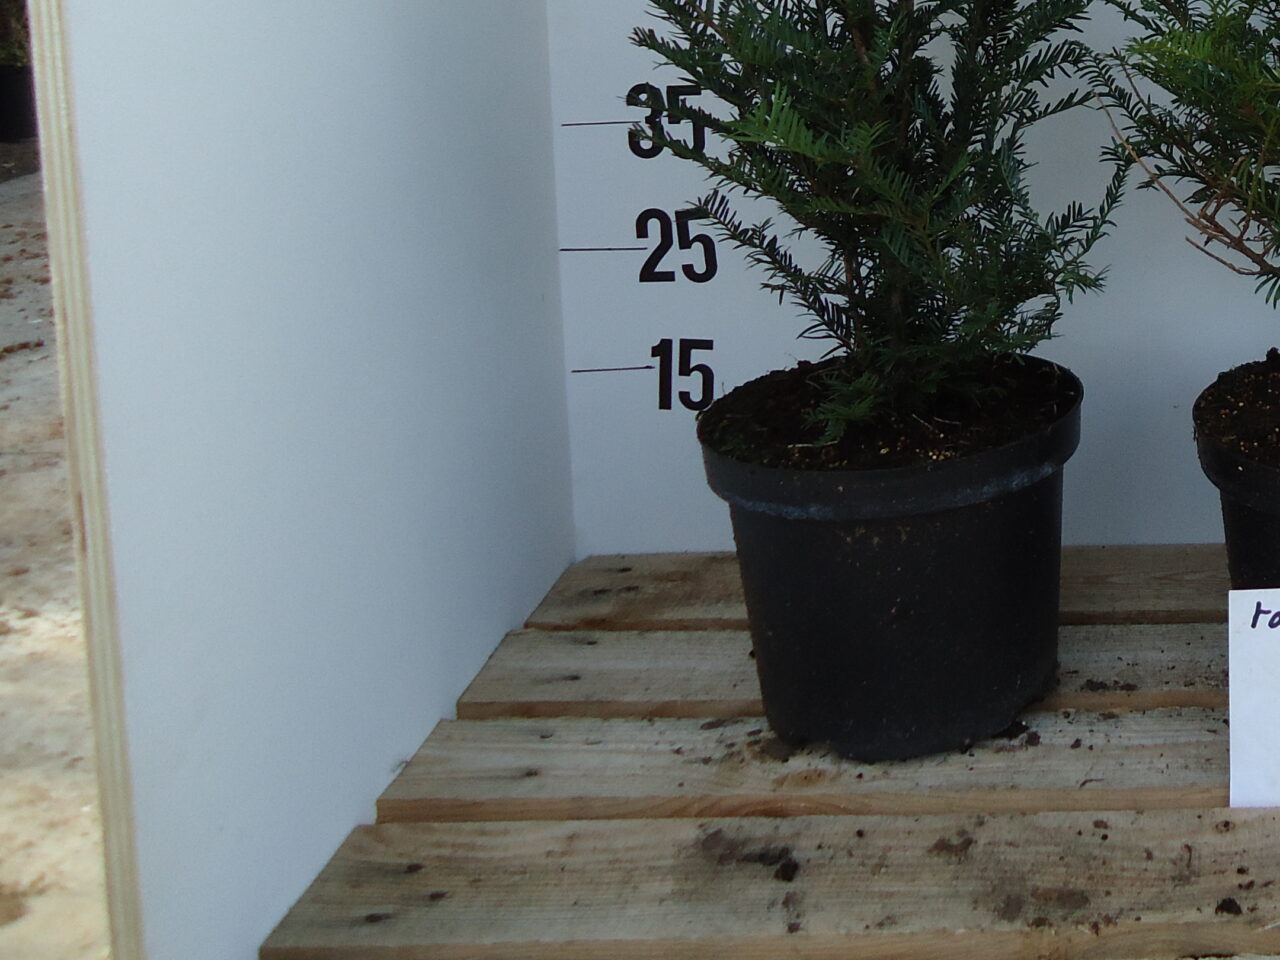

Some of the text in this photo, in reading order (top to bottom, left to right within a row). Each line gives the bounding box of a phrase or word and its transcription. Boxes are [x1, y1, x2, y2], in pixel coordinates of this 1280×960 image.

[626, 82, 707, 159] 35
[635, 208, 718, 283] 25
[650, 338, 714, 411] 15
